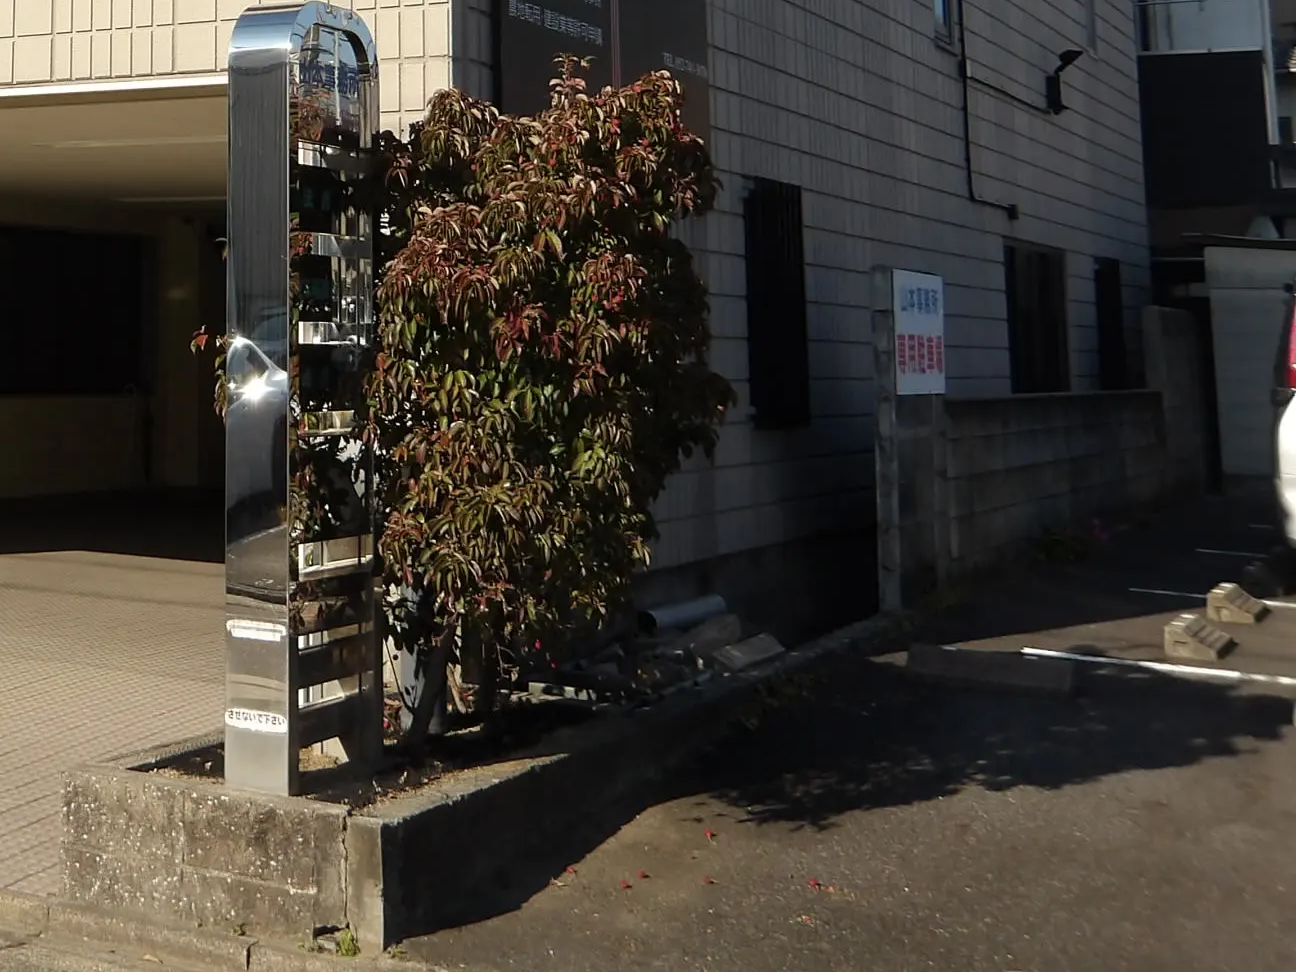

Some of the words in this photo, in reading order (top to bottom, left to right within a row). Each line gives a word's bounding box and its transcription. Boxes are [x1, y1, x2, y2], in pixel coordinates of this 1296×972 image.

[897, 334, 943, 374] 専用駐車場
[227, 710, 285, 725] させないで下さい
